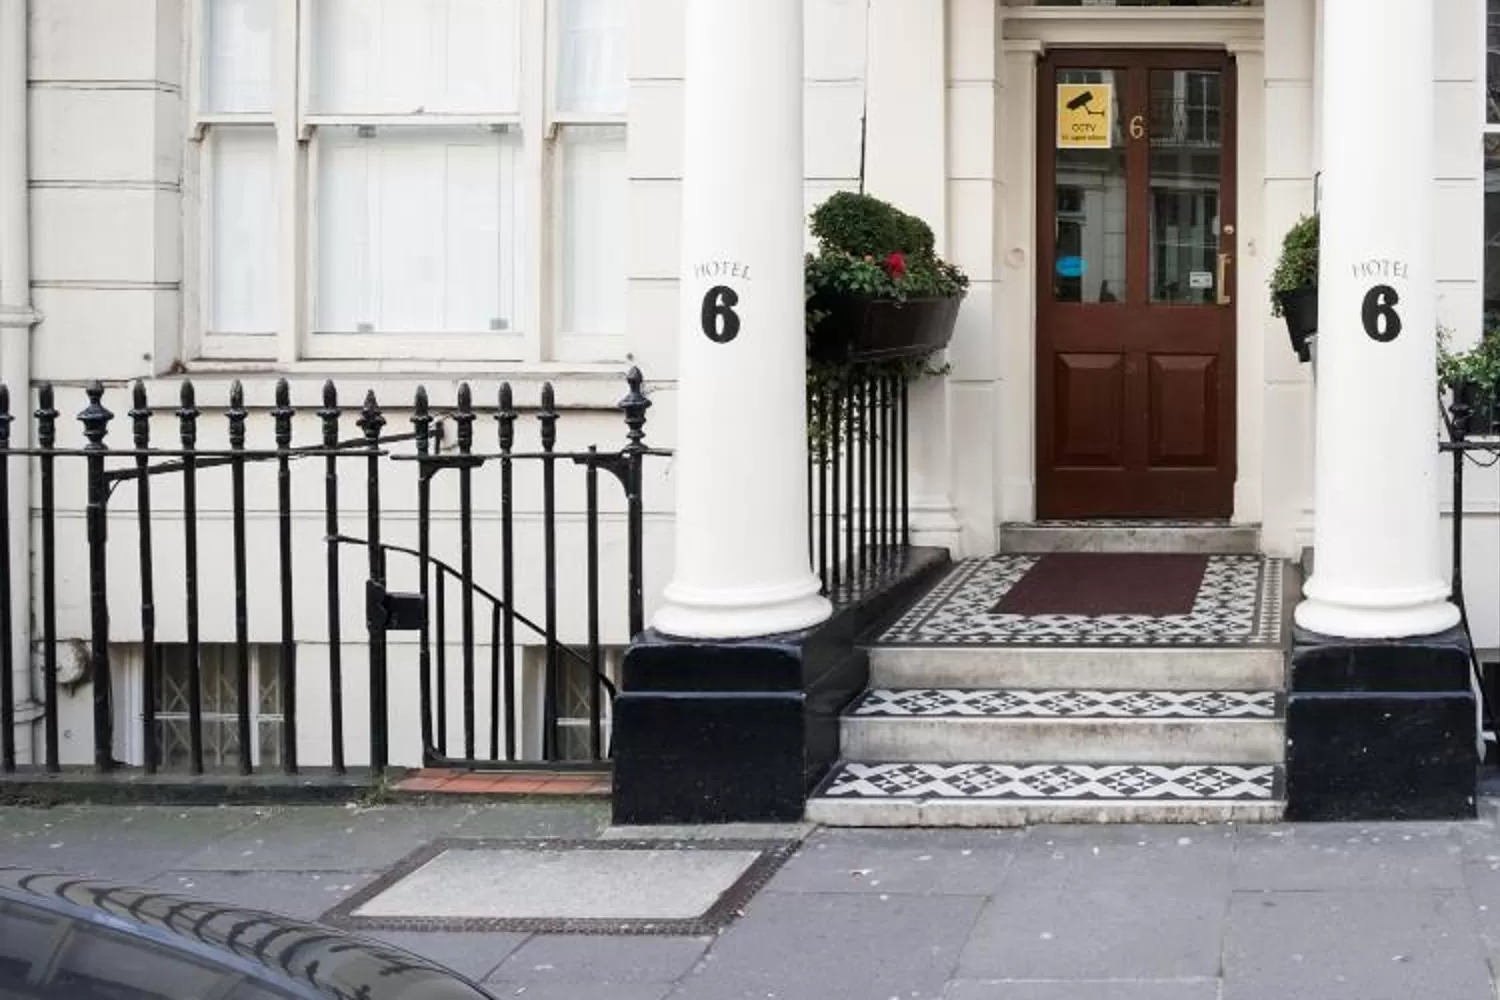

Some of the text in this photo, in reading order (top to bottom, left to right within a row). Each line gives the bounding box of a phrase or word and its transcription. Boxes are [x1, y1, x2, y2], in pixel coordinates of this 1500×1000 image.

[1129, 115, 1145, 139] 6
[693, 260, 752, 281] HOTEL
[1352, 259, 1409, 281] HOTEL
[701, 284, 741, 345] 6
[1361, 284, 1403, 343] 6
